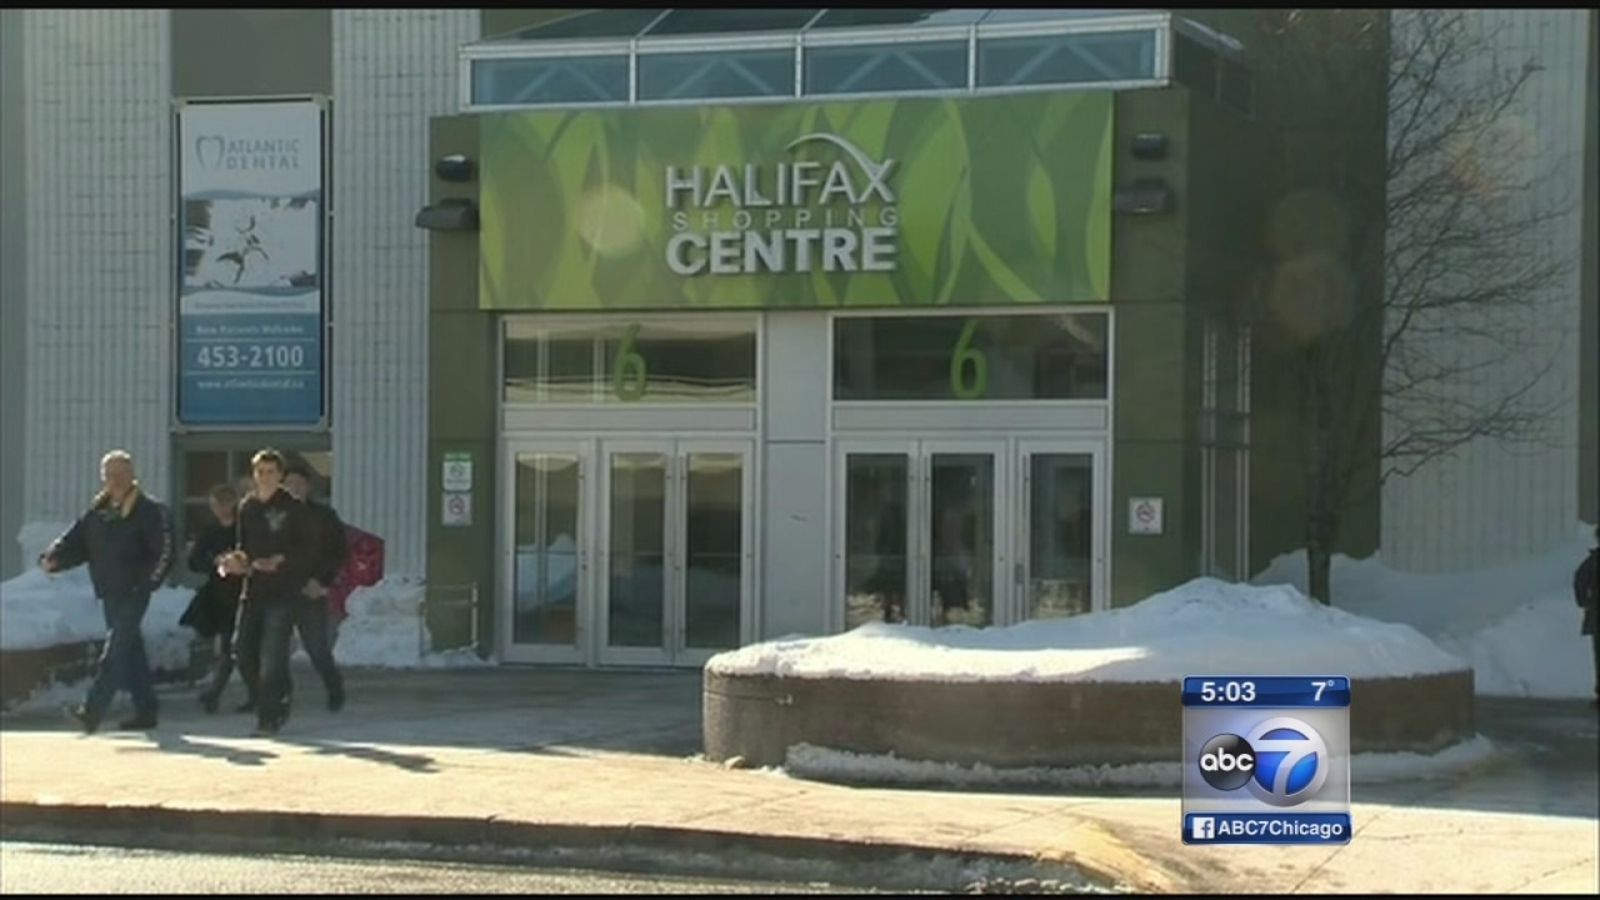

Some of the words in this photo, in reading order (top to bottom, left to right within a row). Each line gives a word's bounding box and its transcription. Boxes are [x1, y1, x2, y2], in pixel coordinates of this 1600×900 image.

[226, 155, 300, 170] DENTAL
[227, 138, 300, 154] ATLANTIC
[665, 140, 895, 208] HALIFAX
[672, 206, 897, 231] SHOPPING
[665, 227, 897, 275] CENTRE
[197, 345, 304, 368] 453-2100
[614, 324, 647, 401] 6
[951, 318, 988, 398] 6
